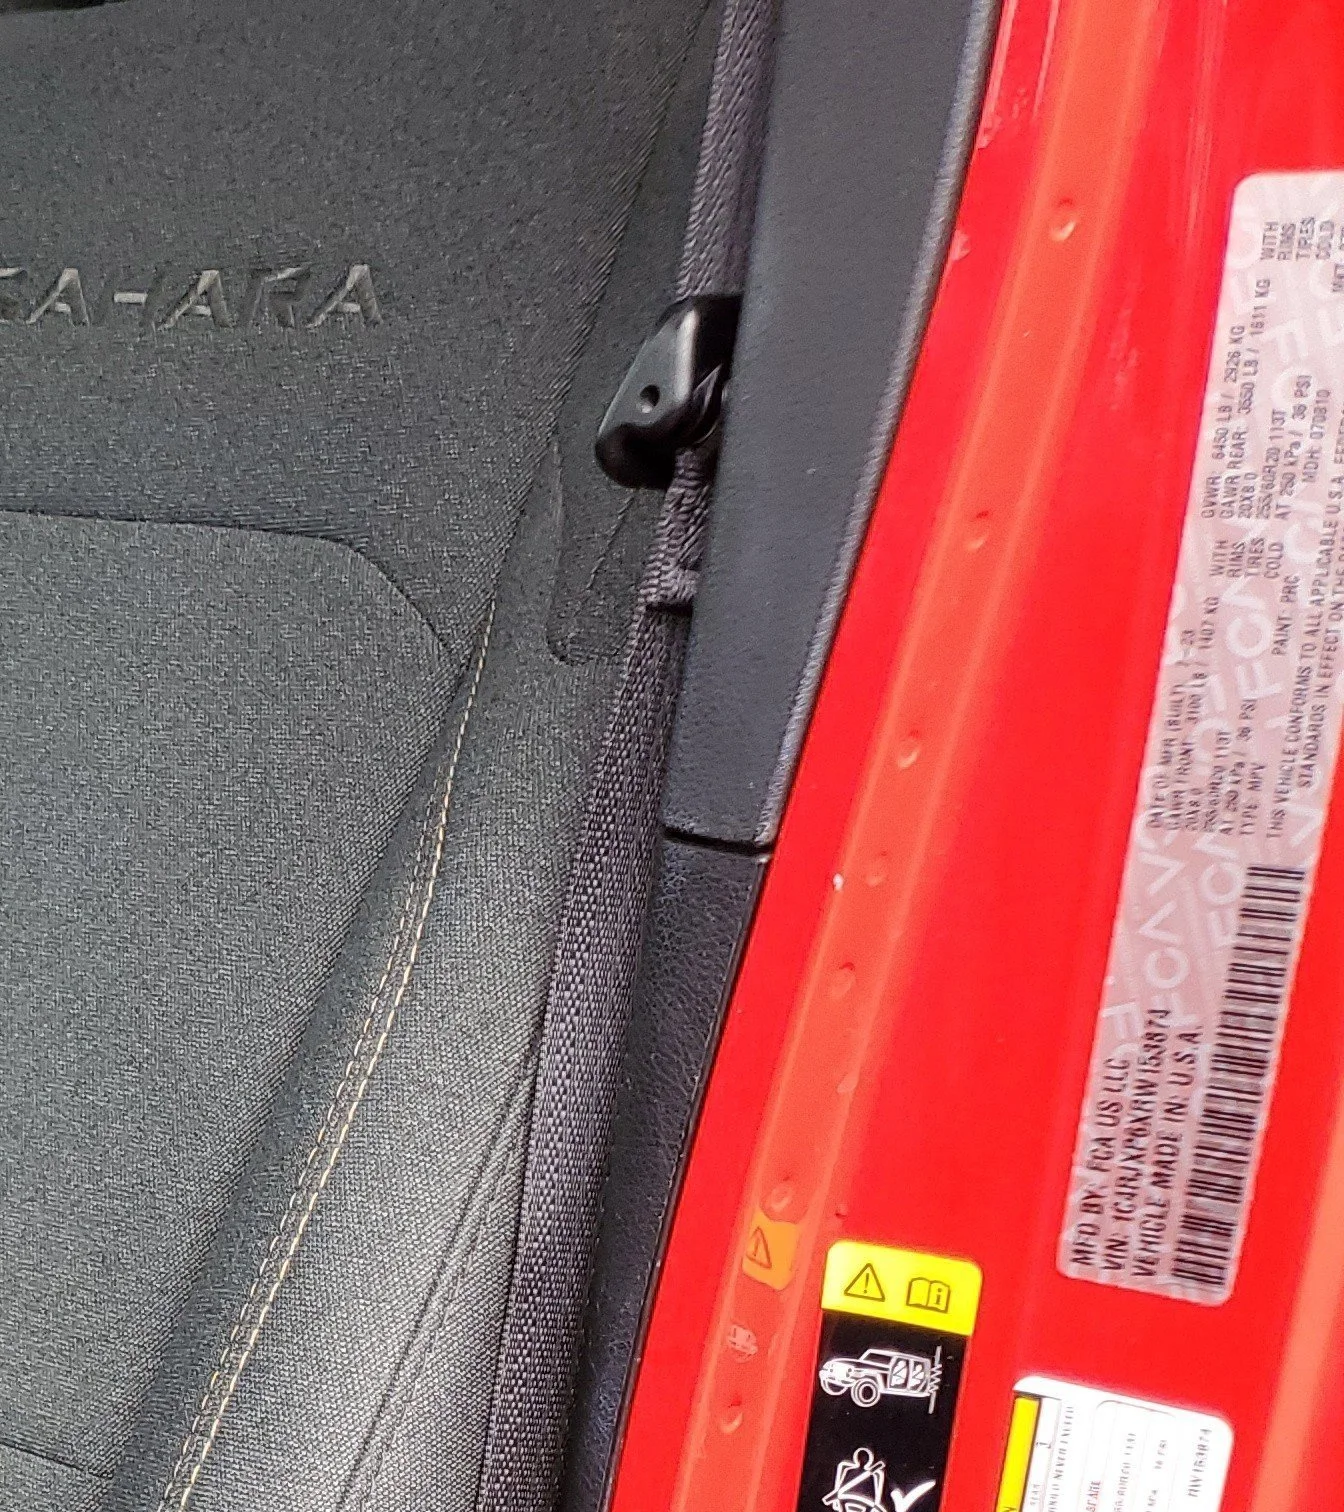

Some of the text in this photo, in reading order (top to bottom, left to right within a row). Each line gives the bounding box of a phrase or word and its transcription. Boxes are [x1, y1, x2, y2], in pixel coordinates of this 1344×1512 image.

[1309, 519, 1338, 607] APPLICABLE
[1303, 608, 1322, 636] ALL
[1299, 641, 1317, 660] TO
[1317, 627, 1340, 679] EFFECT
[1284, 664, 1312, 743] CONFORMS
[1314, 682, 1330, 699] IN
[1297, 702, 1326, 788] STANDARDS
[1272, 747, 1297, 805] VEHICLE
[1100, 1056, 1130, 1093] LLC
[1168, 1022, 1203, 1088] U.S.A.
[1094, 1098, 1123, 1128] US
[1085, 1133, 1116, 1172] FCA
[1149, 1129, 1183, 1190] MADE
[1070, 1221, 1101, 1266] MFD
[1130, 1195, 1170, 1279] VEHICLE
